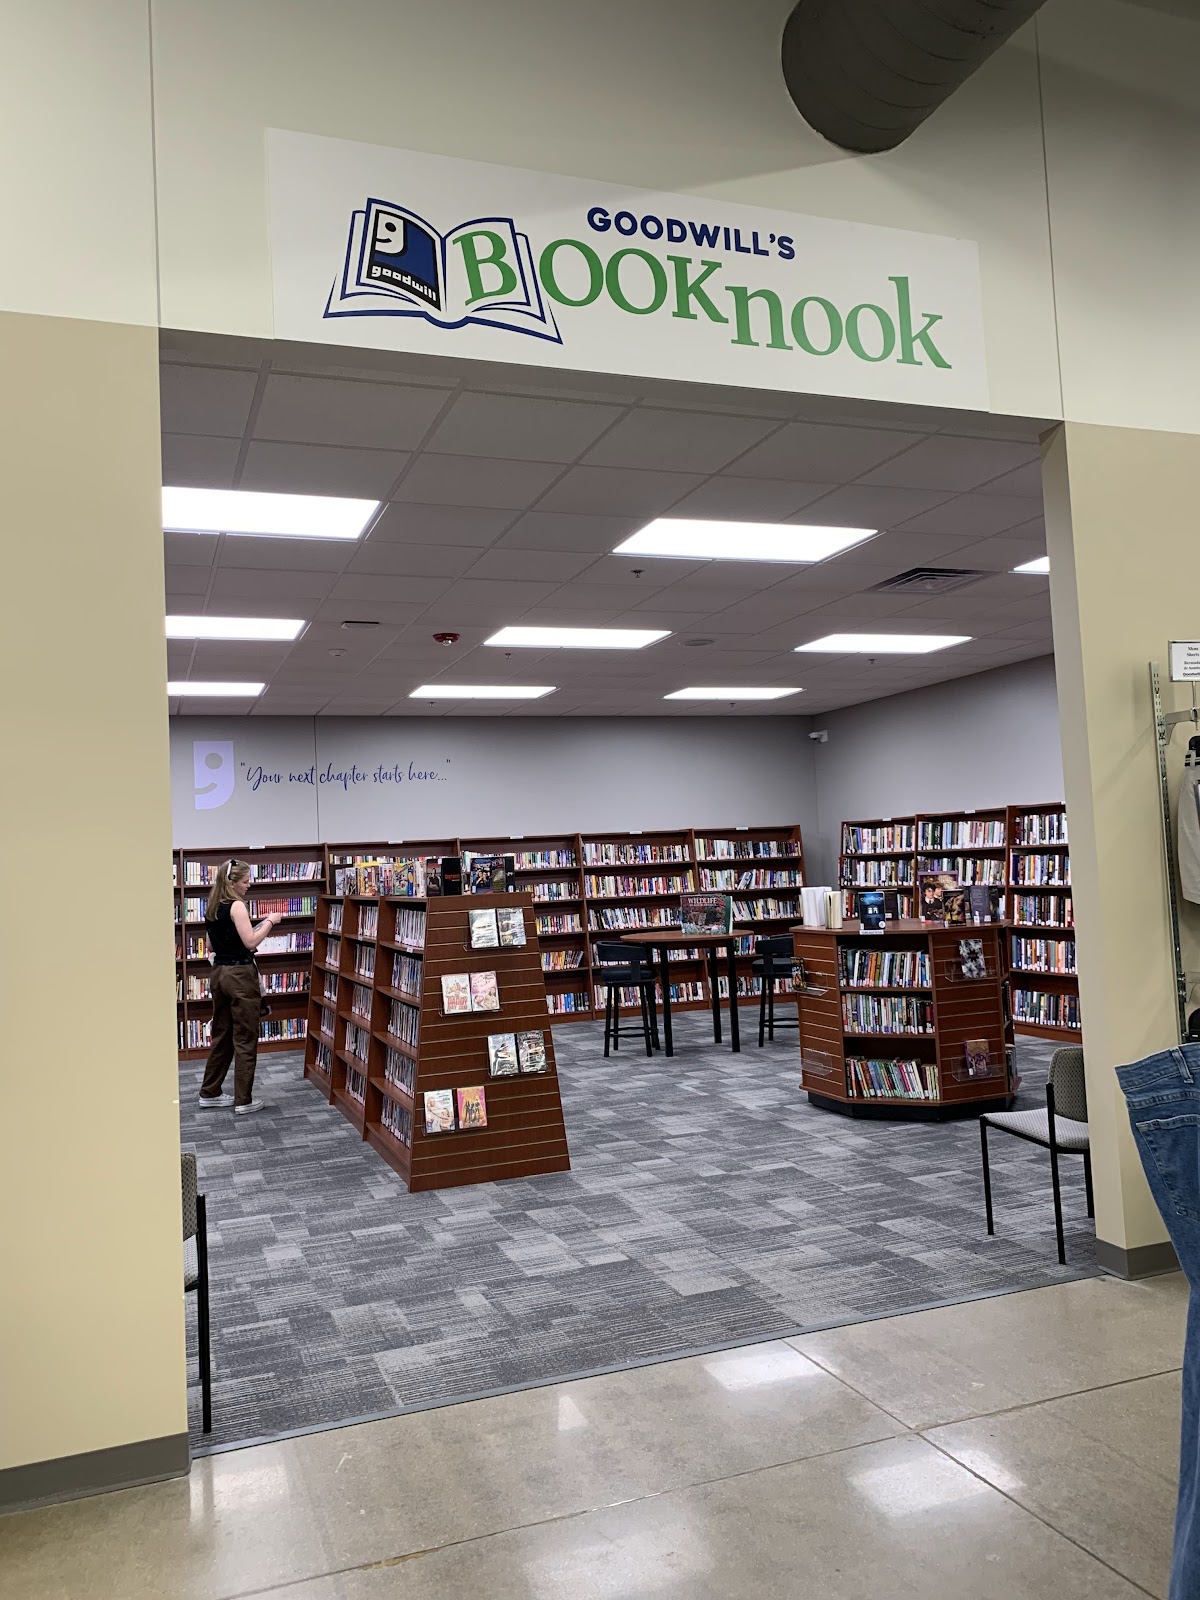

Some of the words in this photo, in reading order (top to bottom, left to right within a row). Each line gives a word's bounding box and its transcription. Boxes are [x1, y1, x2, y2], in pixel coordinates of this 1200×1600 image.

[587, 207, 795, 260] GOODWILL'S
[371, 265, 437, 302] goodwill
[288, 765, 317, 785] next
[319, 762, 368, 791] chapter
[373, 764, 405, 784] starts
